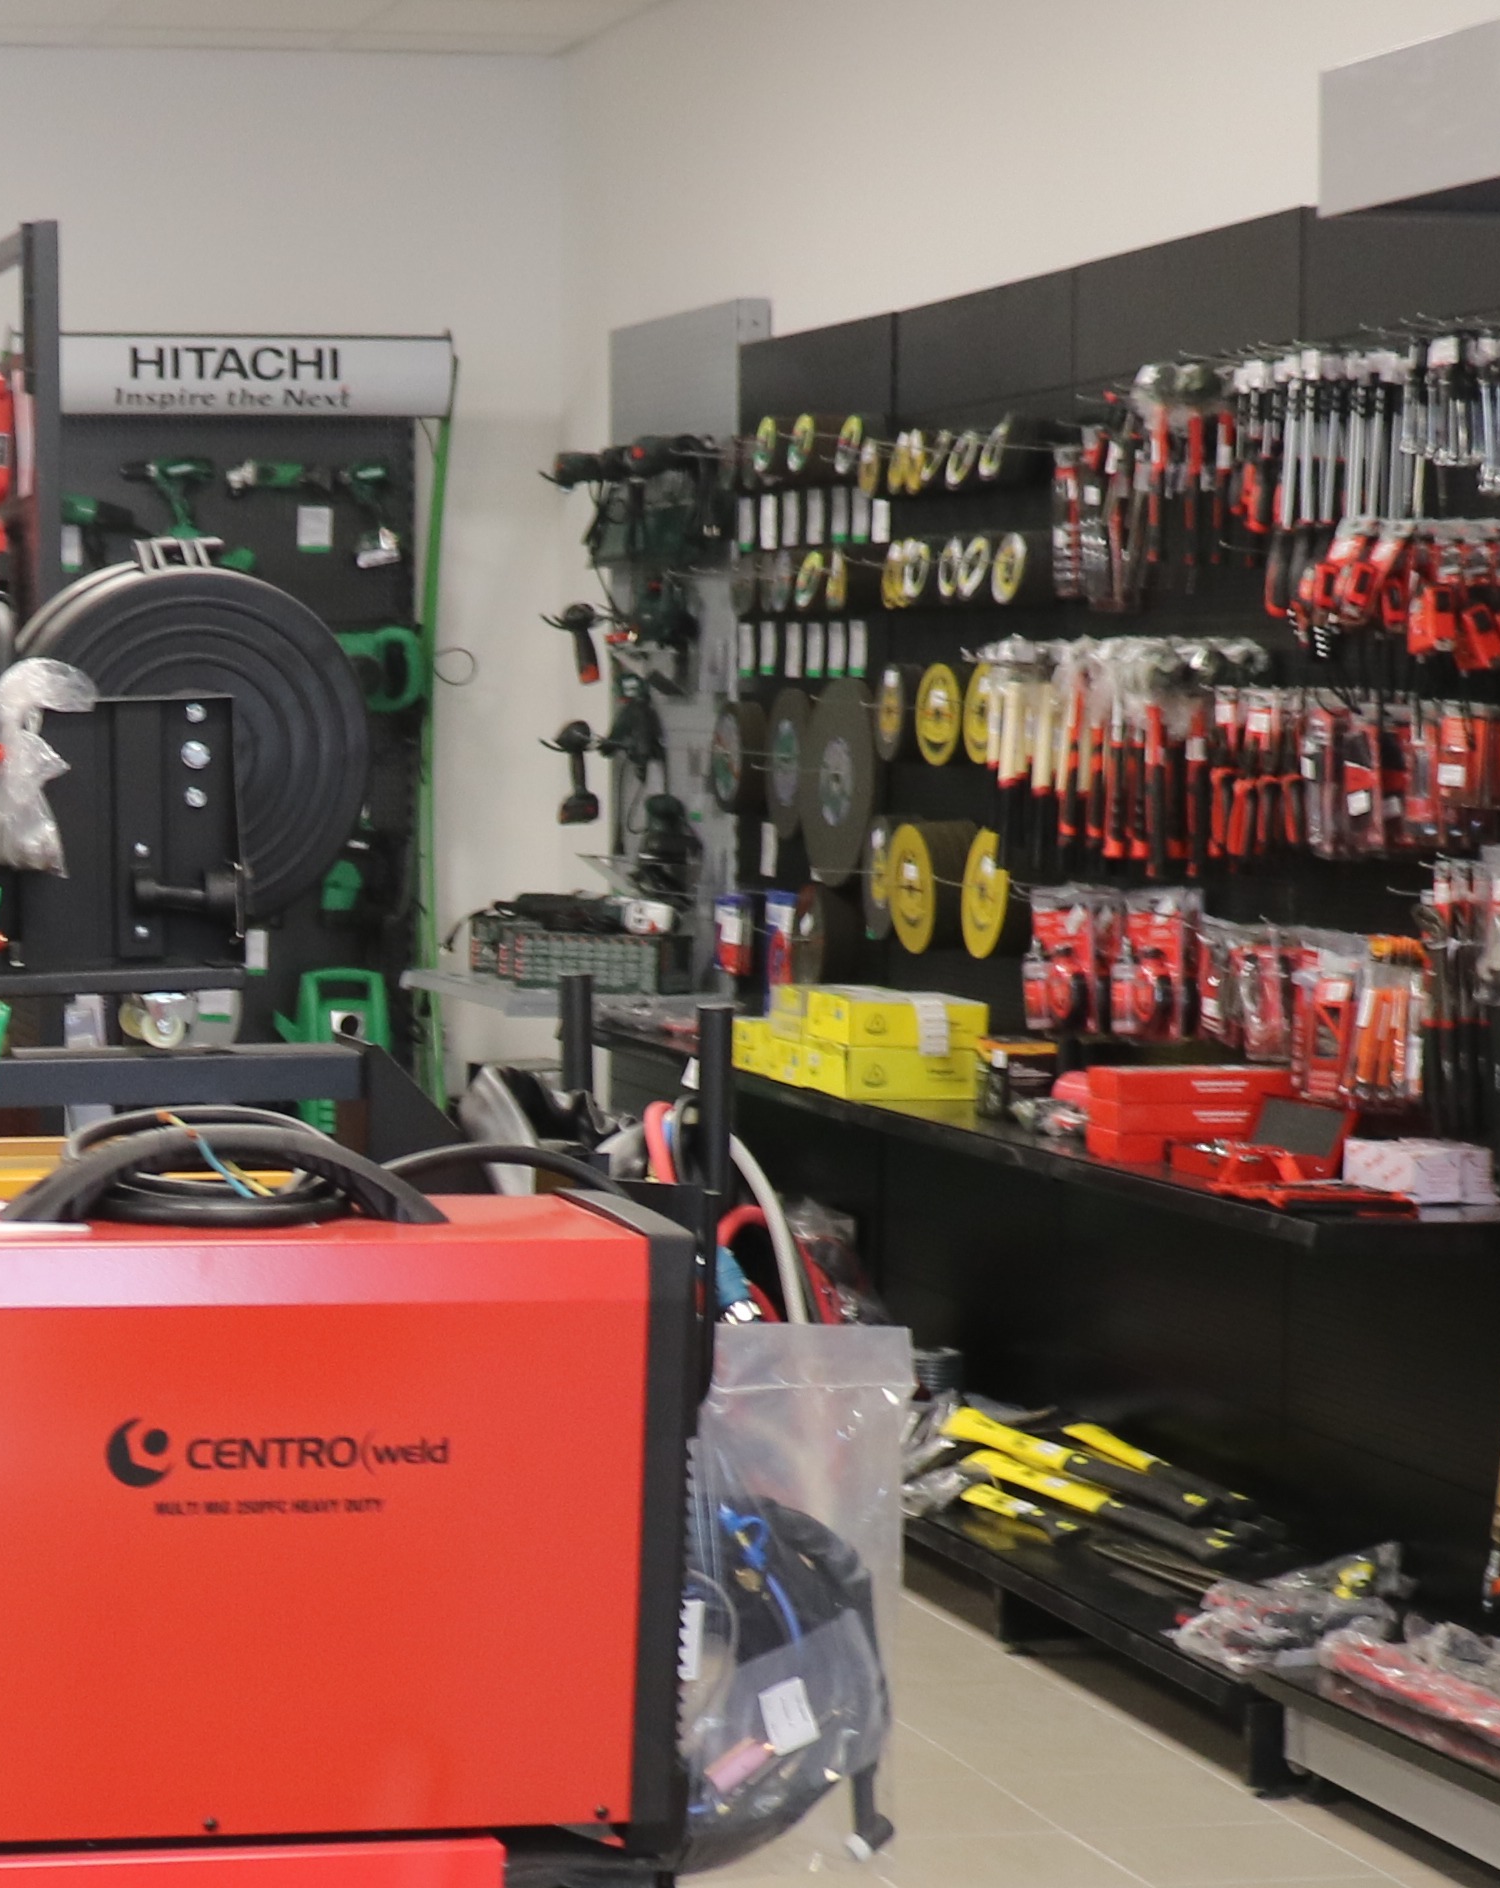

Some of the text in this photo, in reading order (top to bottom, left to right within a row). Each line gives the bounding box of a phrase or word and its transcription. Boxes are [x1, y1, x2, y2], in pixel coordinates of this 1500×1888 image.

[130, 347, 341, 380] HITACHI
[115, 387, 352, 409] Inspire the Next
